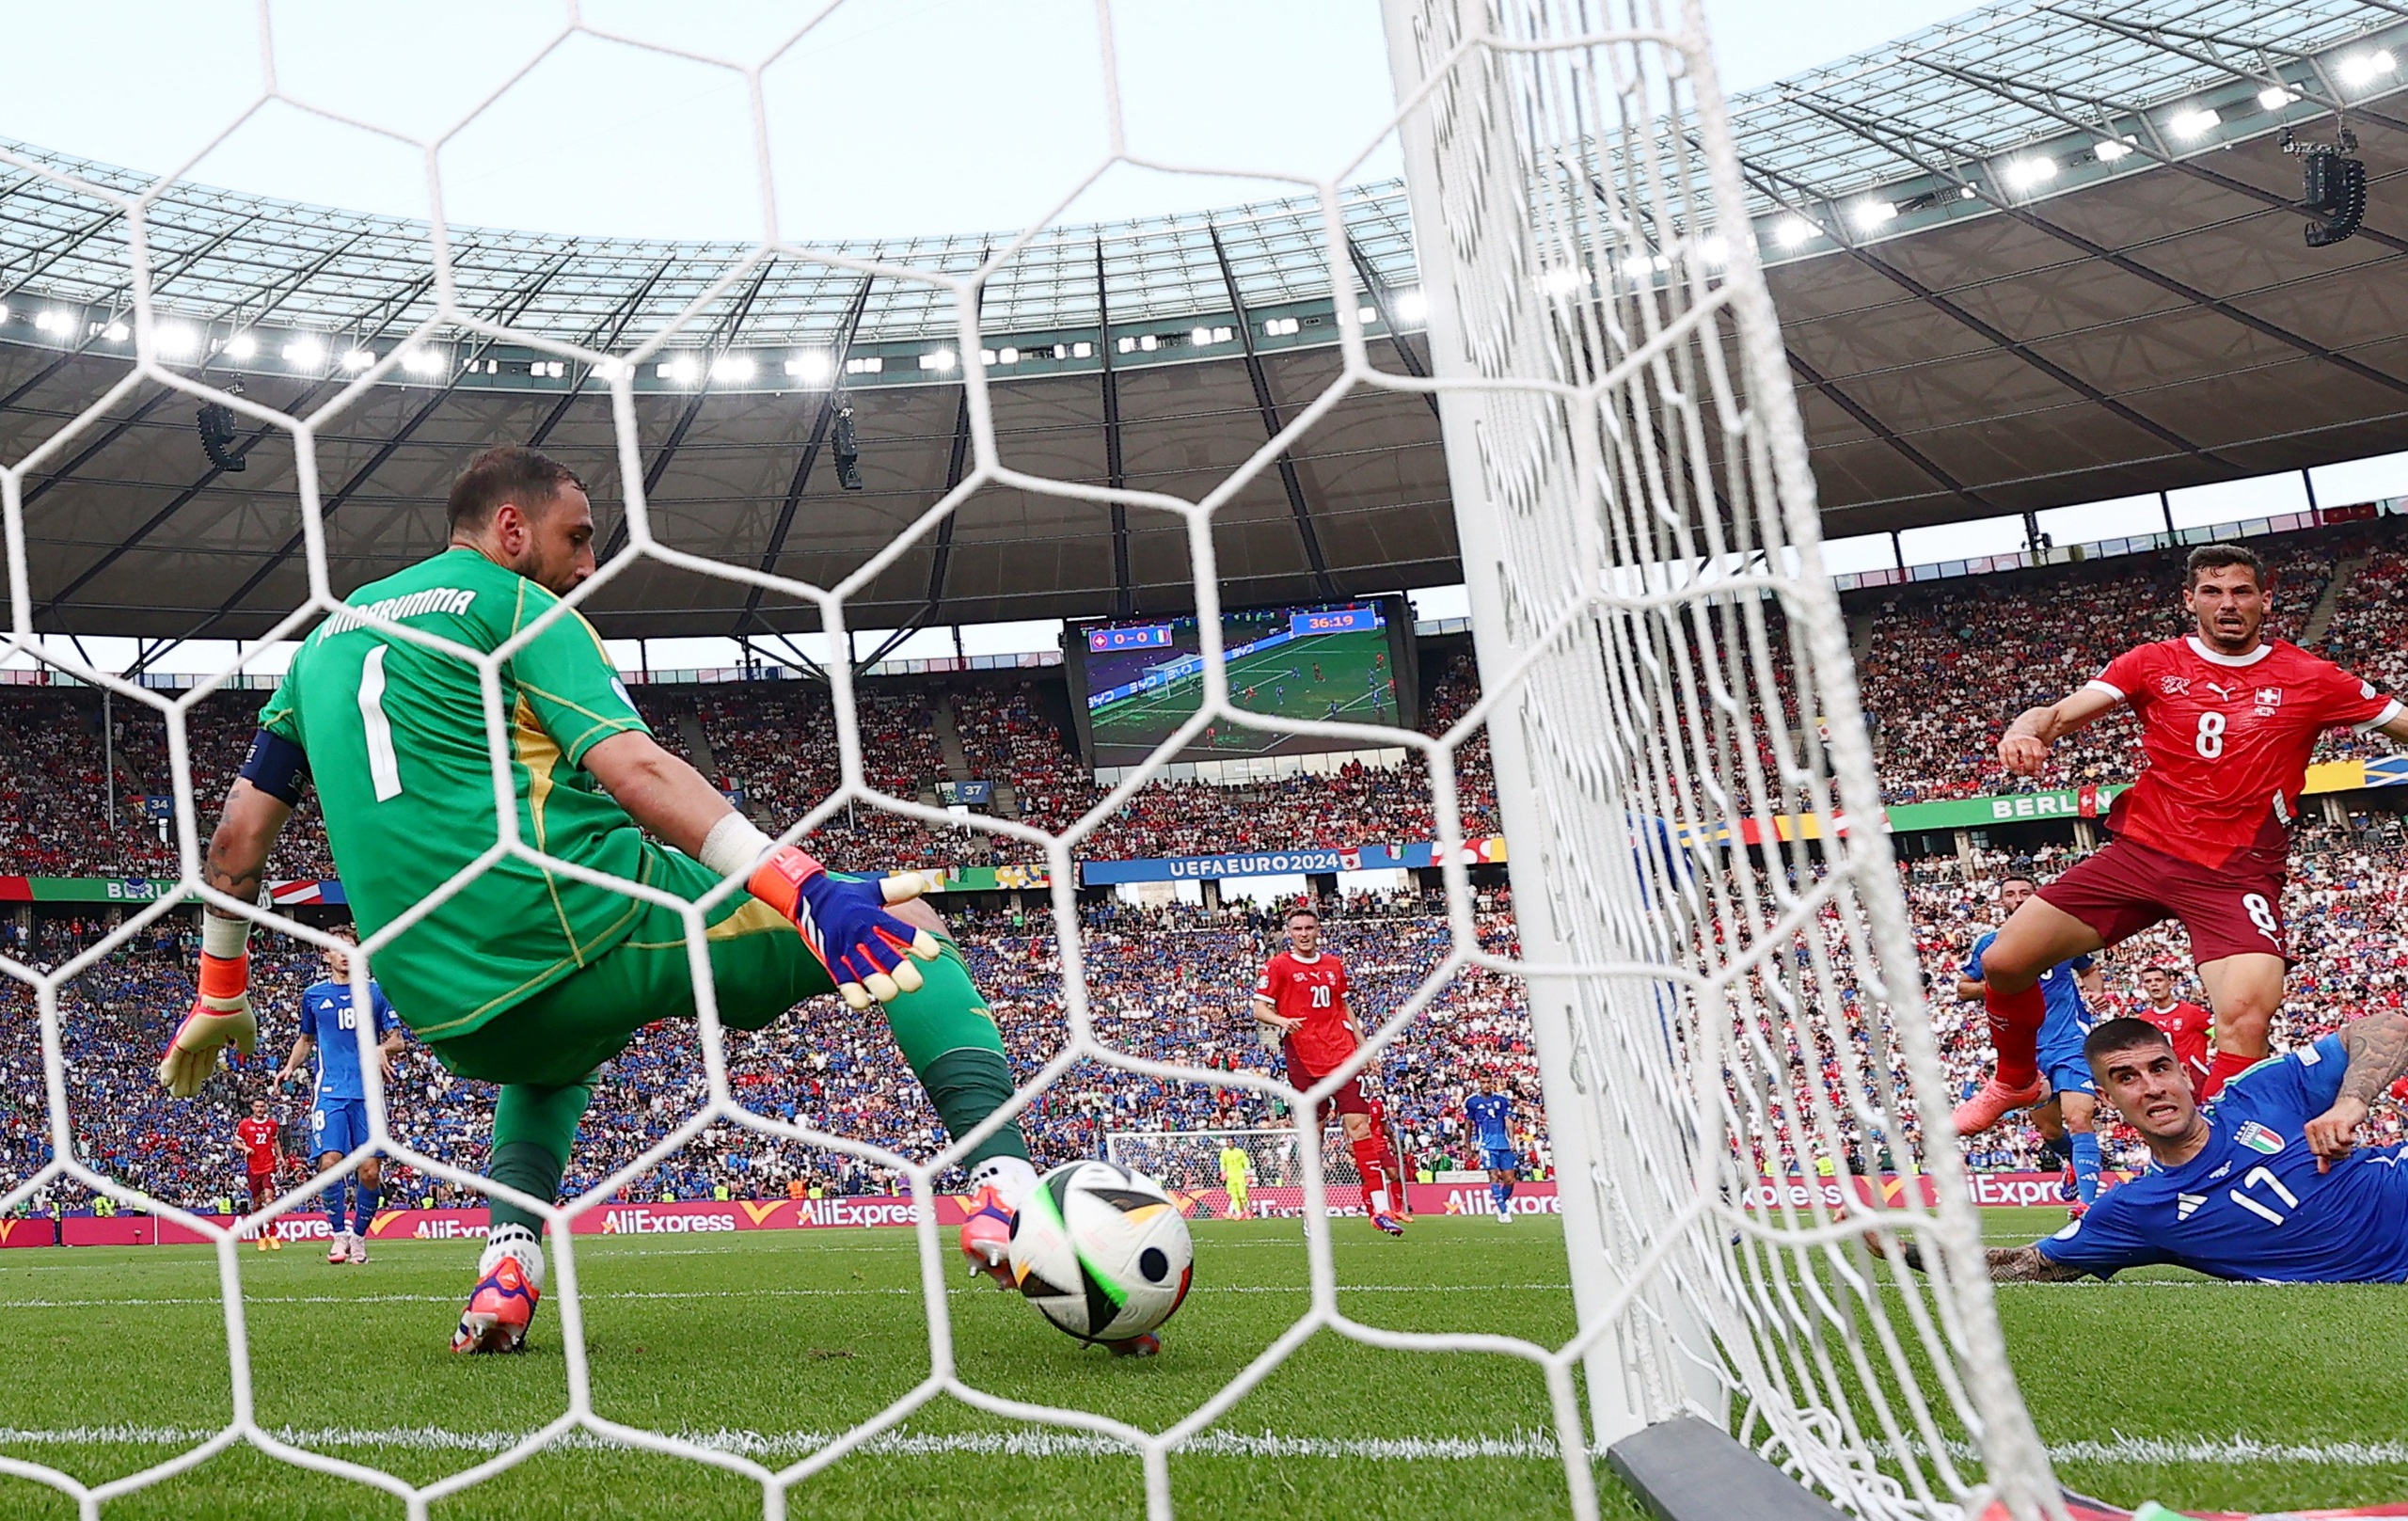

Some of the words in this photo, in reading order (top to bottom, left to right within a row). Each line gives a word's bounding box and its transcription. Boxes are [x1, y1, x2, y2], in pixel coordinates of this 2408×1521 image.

[1308, 615, 1354, 629] 36:19
[356, 644, 403, 803] 1
[2195, 711, 2226, 759] 8
[964, 784, 983, 796] 37
[150, 799, 169, 810] 34
[1991, 790, 2113, 819] BERLN
[2242, 893, 2278, 932] 8
[1309, 985, 1331, 1008] 20
[338, 1007, 356, 1031] 18
[255, 1133, 267, 1145] 22
[2229, 1165, 2300, 1227] 17
[601, 1210, 736, 1234] AliExpress
